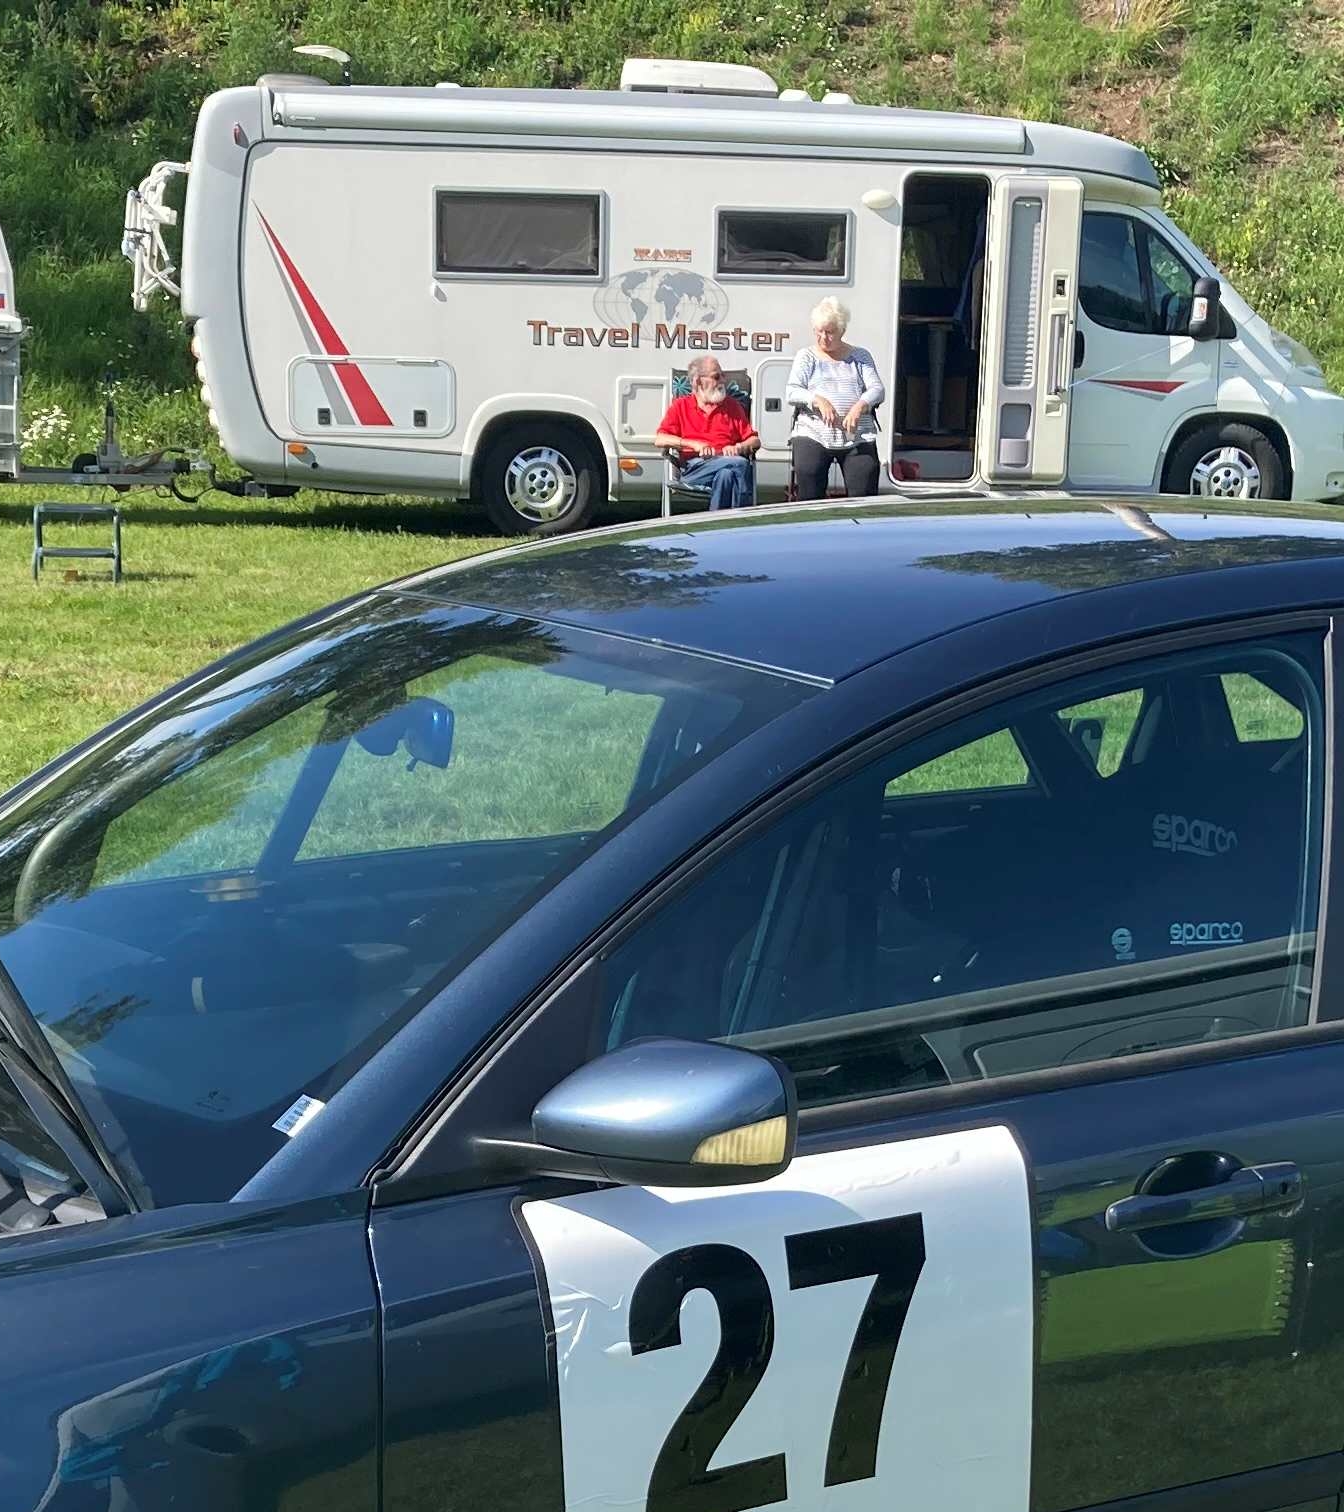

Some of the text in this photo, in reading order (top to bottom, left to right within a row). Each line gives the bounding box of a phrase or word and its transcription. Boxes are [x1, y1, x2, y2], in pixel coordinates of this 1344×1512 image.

[527, 320, 790, 352] Travel Master
[1170, 921, 1244, 945] sparco
